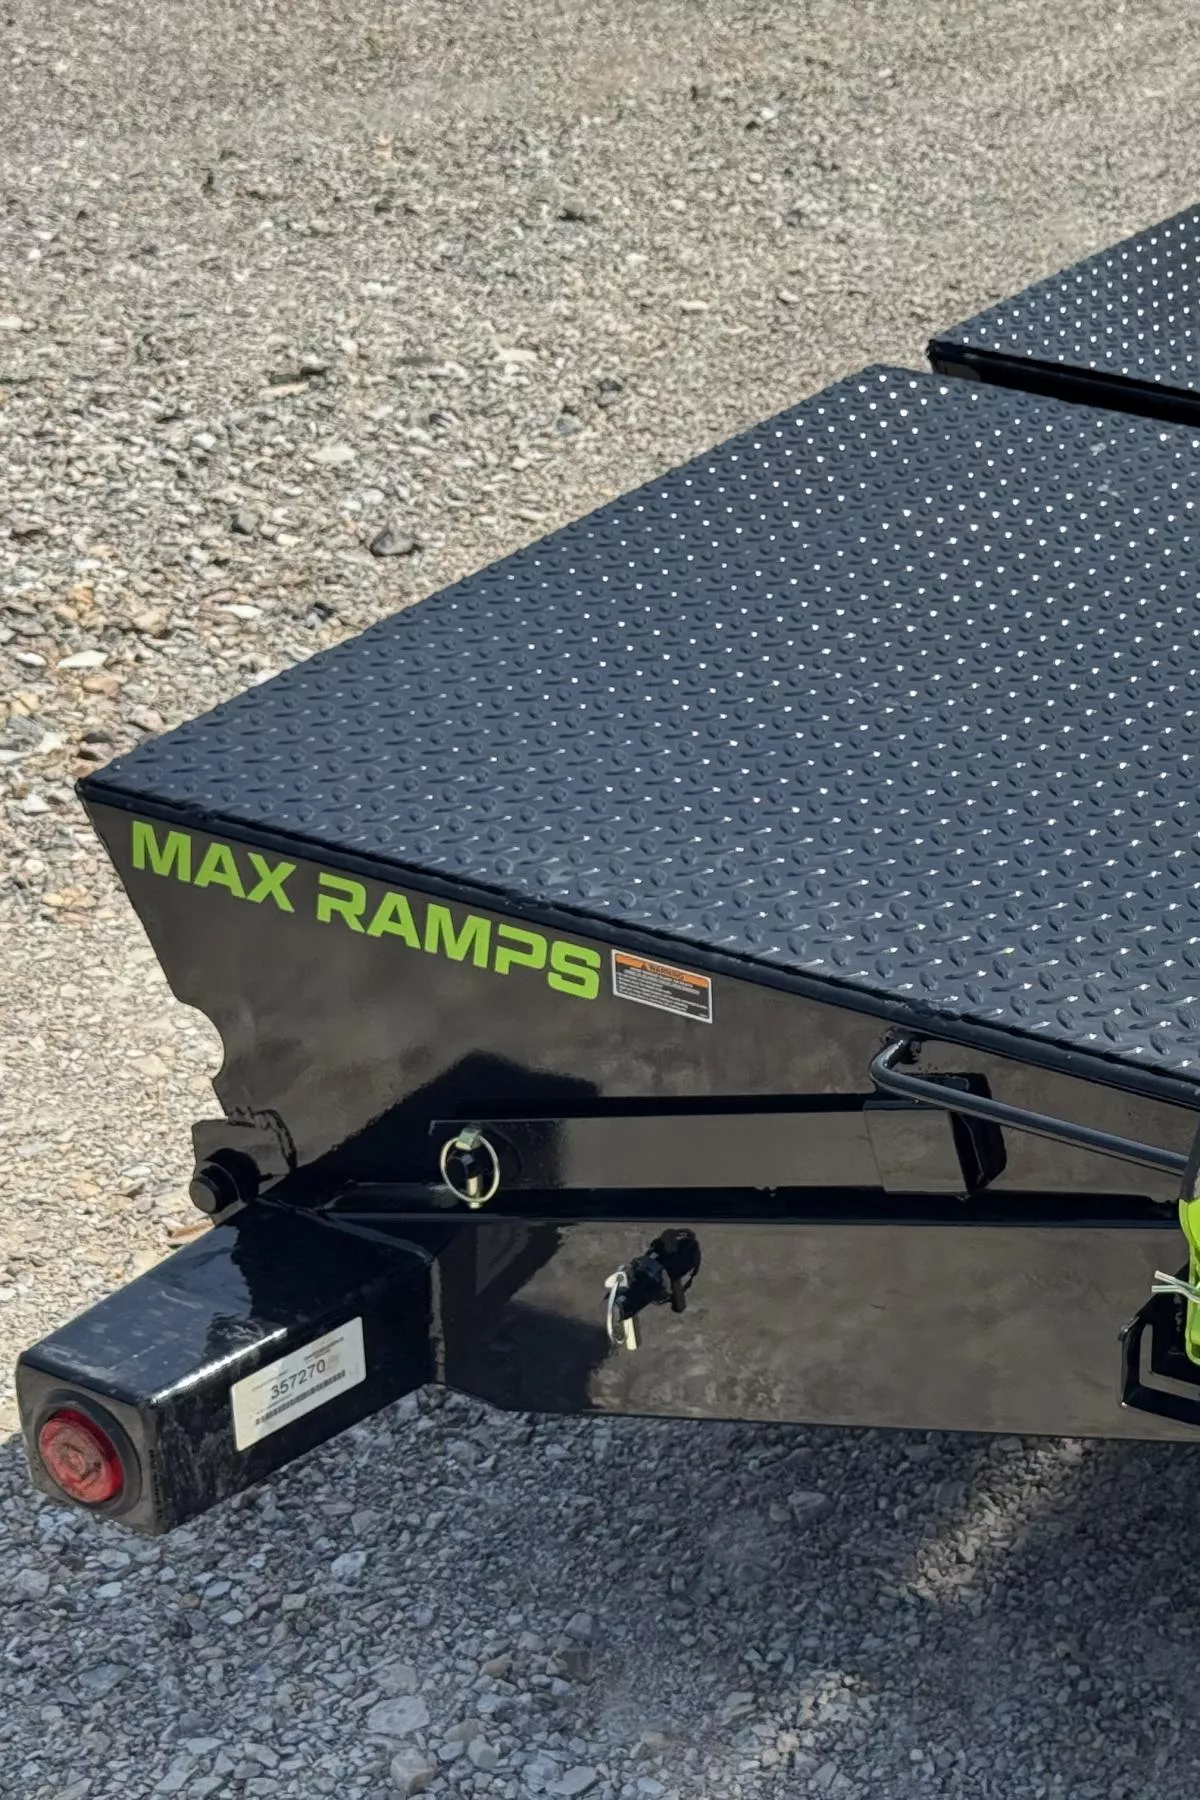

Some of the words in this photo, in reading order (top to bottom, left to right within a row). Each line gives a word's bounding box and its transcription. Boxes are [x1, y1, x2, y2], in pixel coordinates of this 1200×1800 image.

[132, 821, 296, 911] MAX
[316, 873, 600, 1001] RAMPS
[270, 1358, 327, 1400] 357270
